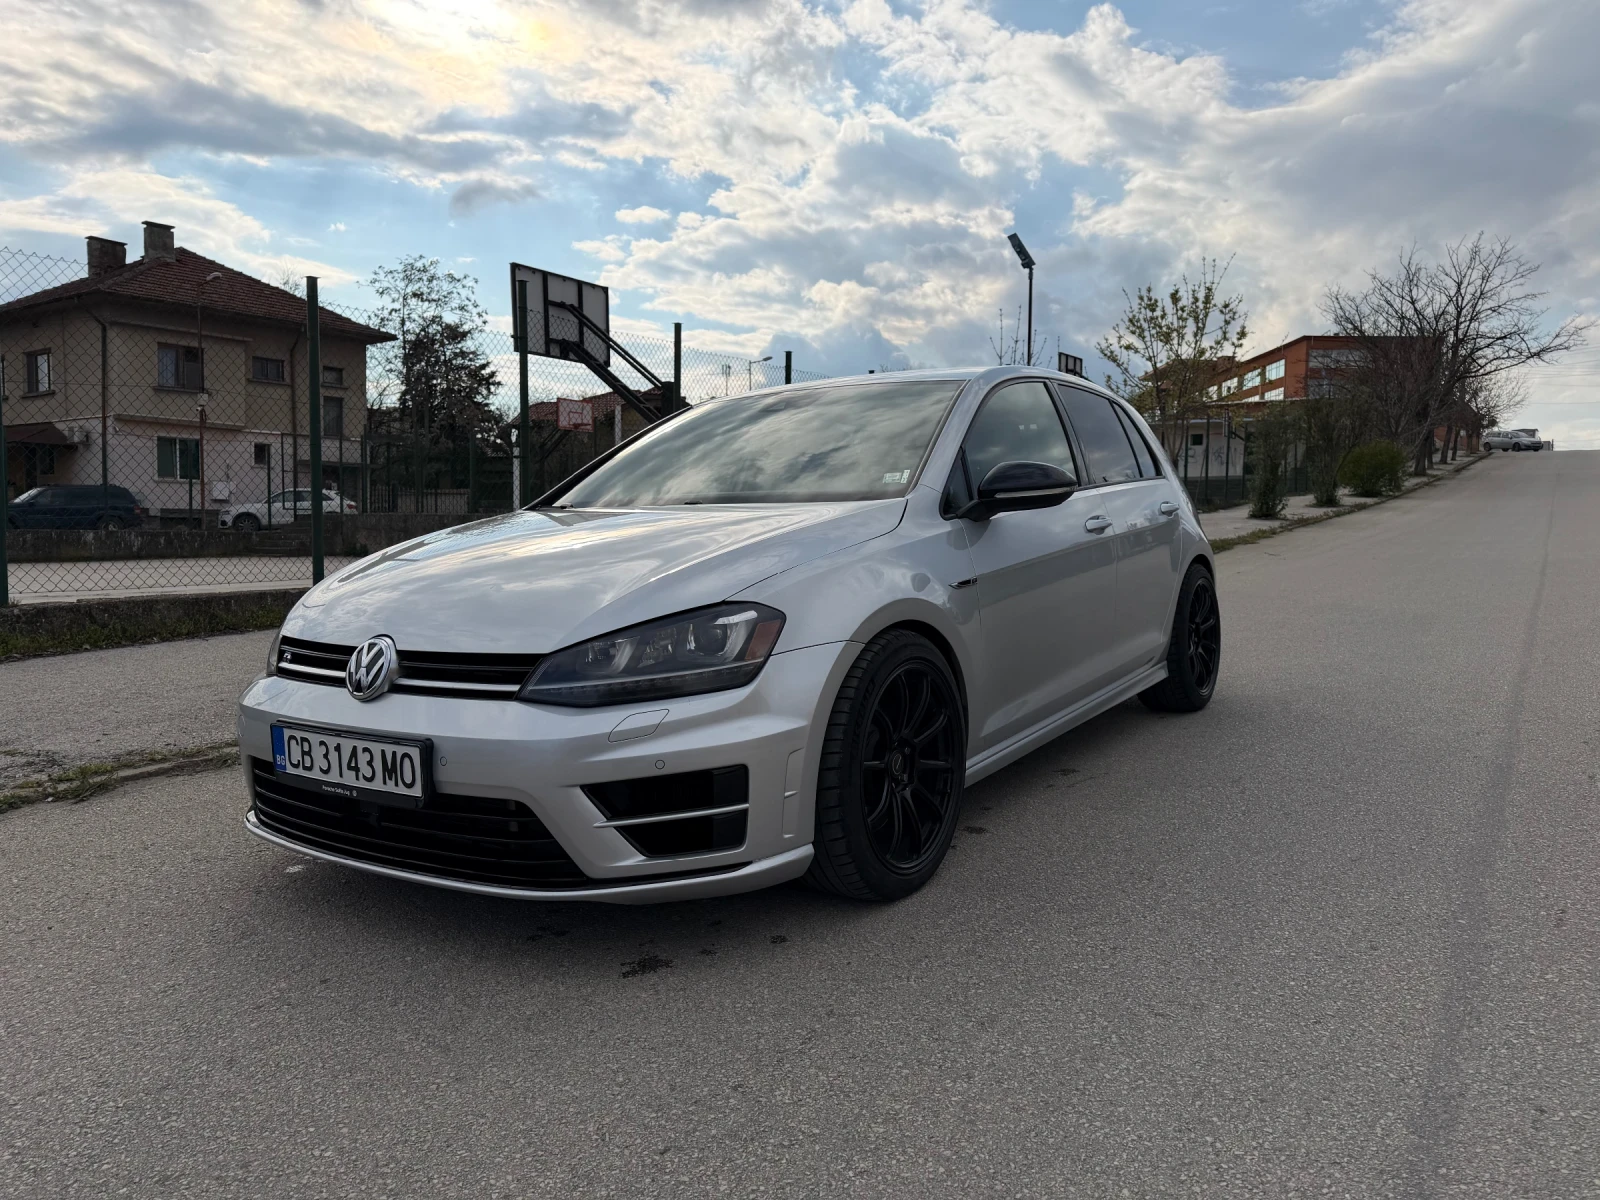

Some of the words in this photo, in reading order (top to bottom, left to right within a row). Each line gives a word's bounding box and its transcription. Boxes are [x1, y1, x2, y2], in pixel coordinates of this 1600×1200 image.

[276, 754, 286, 766] BG
[287, 734, 314, 771] CB
[318, 739, 376, 783] 3143
[380, 748, 416, 789] MO
